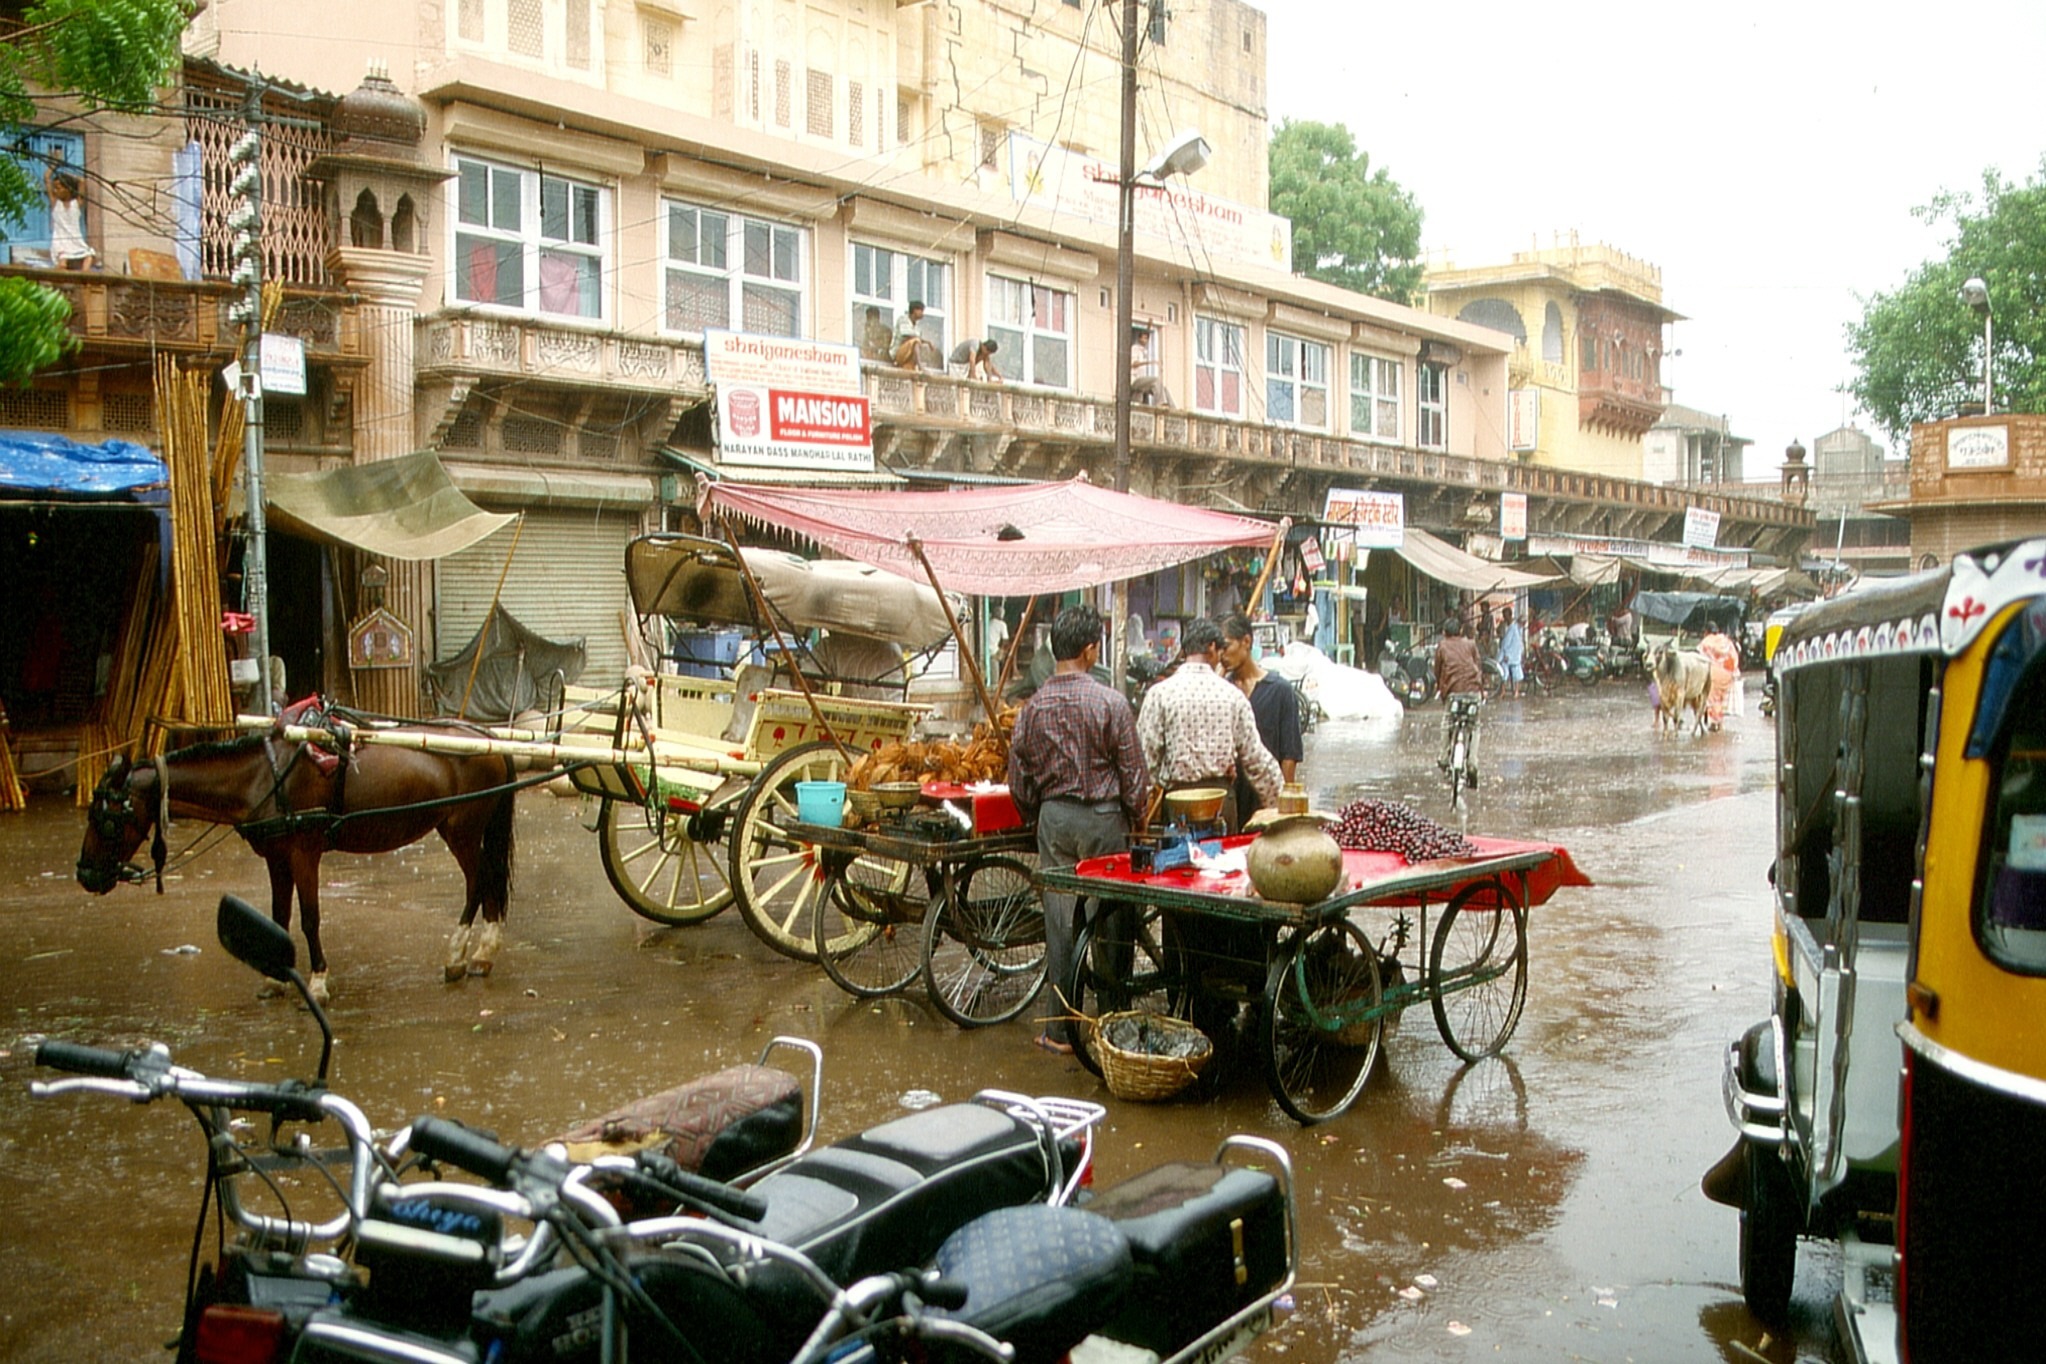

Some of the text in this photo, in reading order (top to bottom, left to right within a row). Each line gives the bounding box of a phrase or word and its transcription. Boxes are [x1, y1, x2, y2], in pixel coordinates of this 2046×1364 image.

[1082, 162, 1243, 225] shrganesham
[778, 396, 863, 428] MANSION
[779, 429, 801, 437] FLOOR
[807, 430, 841, 440] FURNITURE
[841, 433, 863, 441] POLISH
[724, 443, 764, 455] NARAYAN
[766, 447, 788, 458] DASS
[848, 452, 871, 463] RATHI
